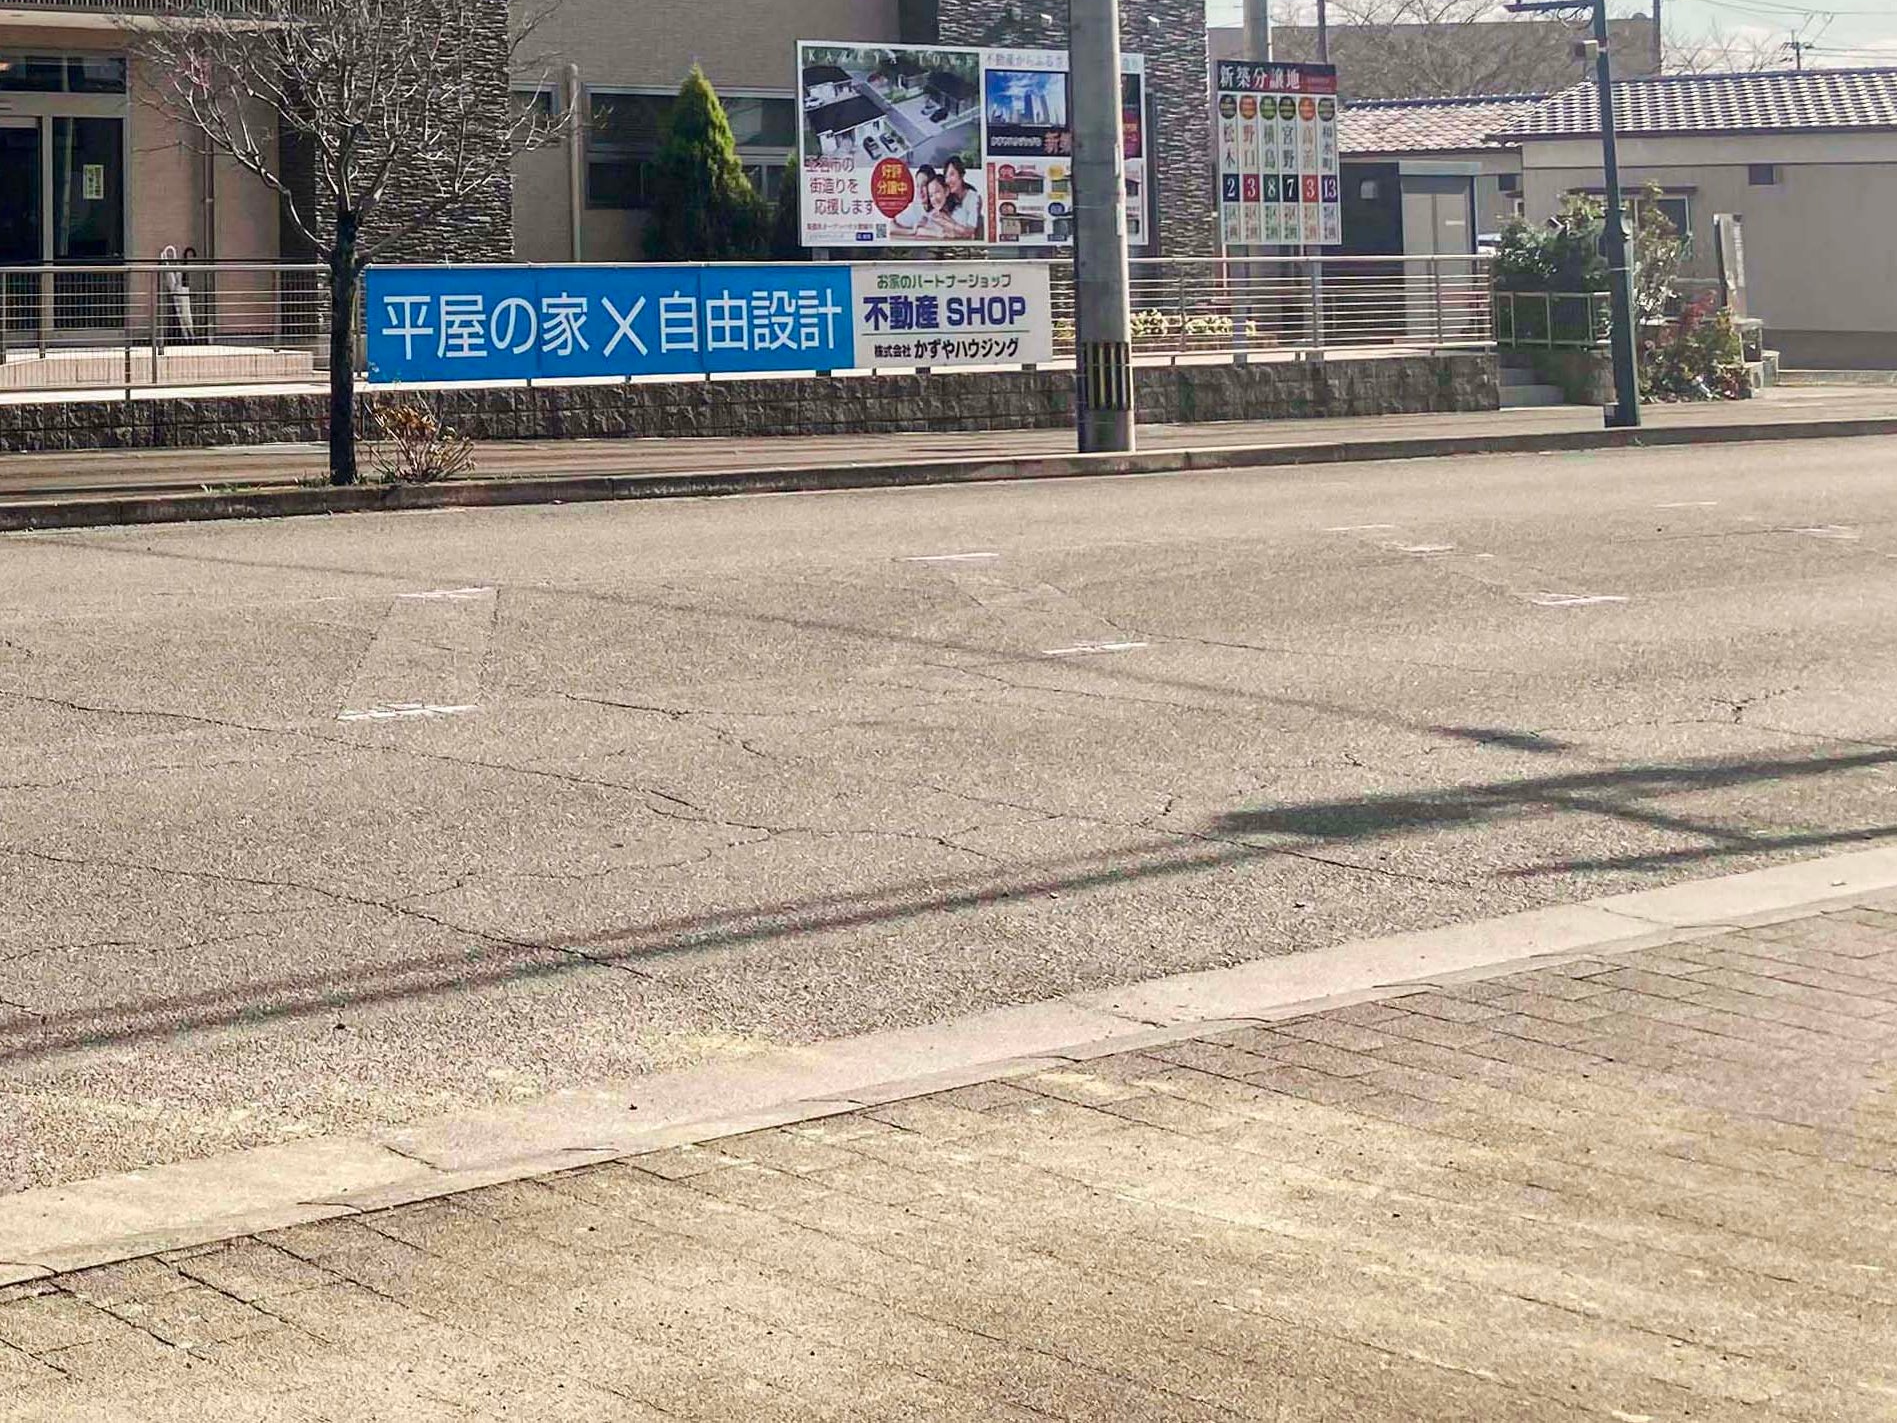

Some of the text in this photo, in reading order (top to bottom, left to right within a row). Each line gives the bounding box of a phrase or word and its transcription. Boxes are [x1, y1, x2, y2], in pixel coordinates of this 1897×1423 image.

[1219, 65, 1301, 89] 新築分譲地
[810, 178, 859, 194] 街造りを
[1227, 178, 1236, 197] 2
[1247, 178, 1256, 197] 3
[1267, 178, 1276, 197] 8
[1286, 178, 1294, 197] 7
[1306, 179, 1315, 198] 3
[1324, 178, 1337, 198] 13
[814, 198, 873, 215] 応援します
[877, 274, 1012, 290] お家のパートナーショップ
[863, 295, 1026, 331] 不動産 SHOP
[874, 338, 1019, 359] 株式会社 かずやハウジング
